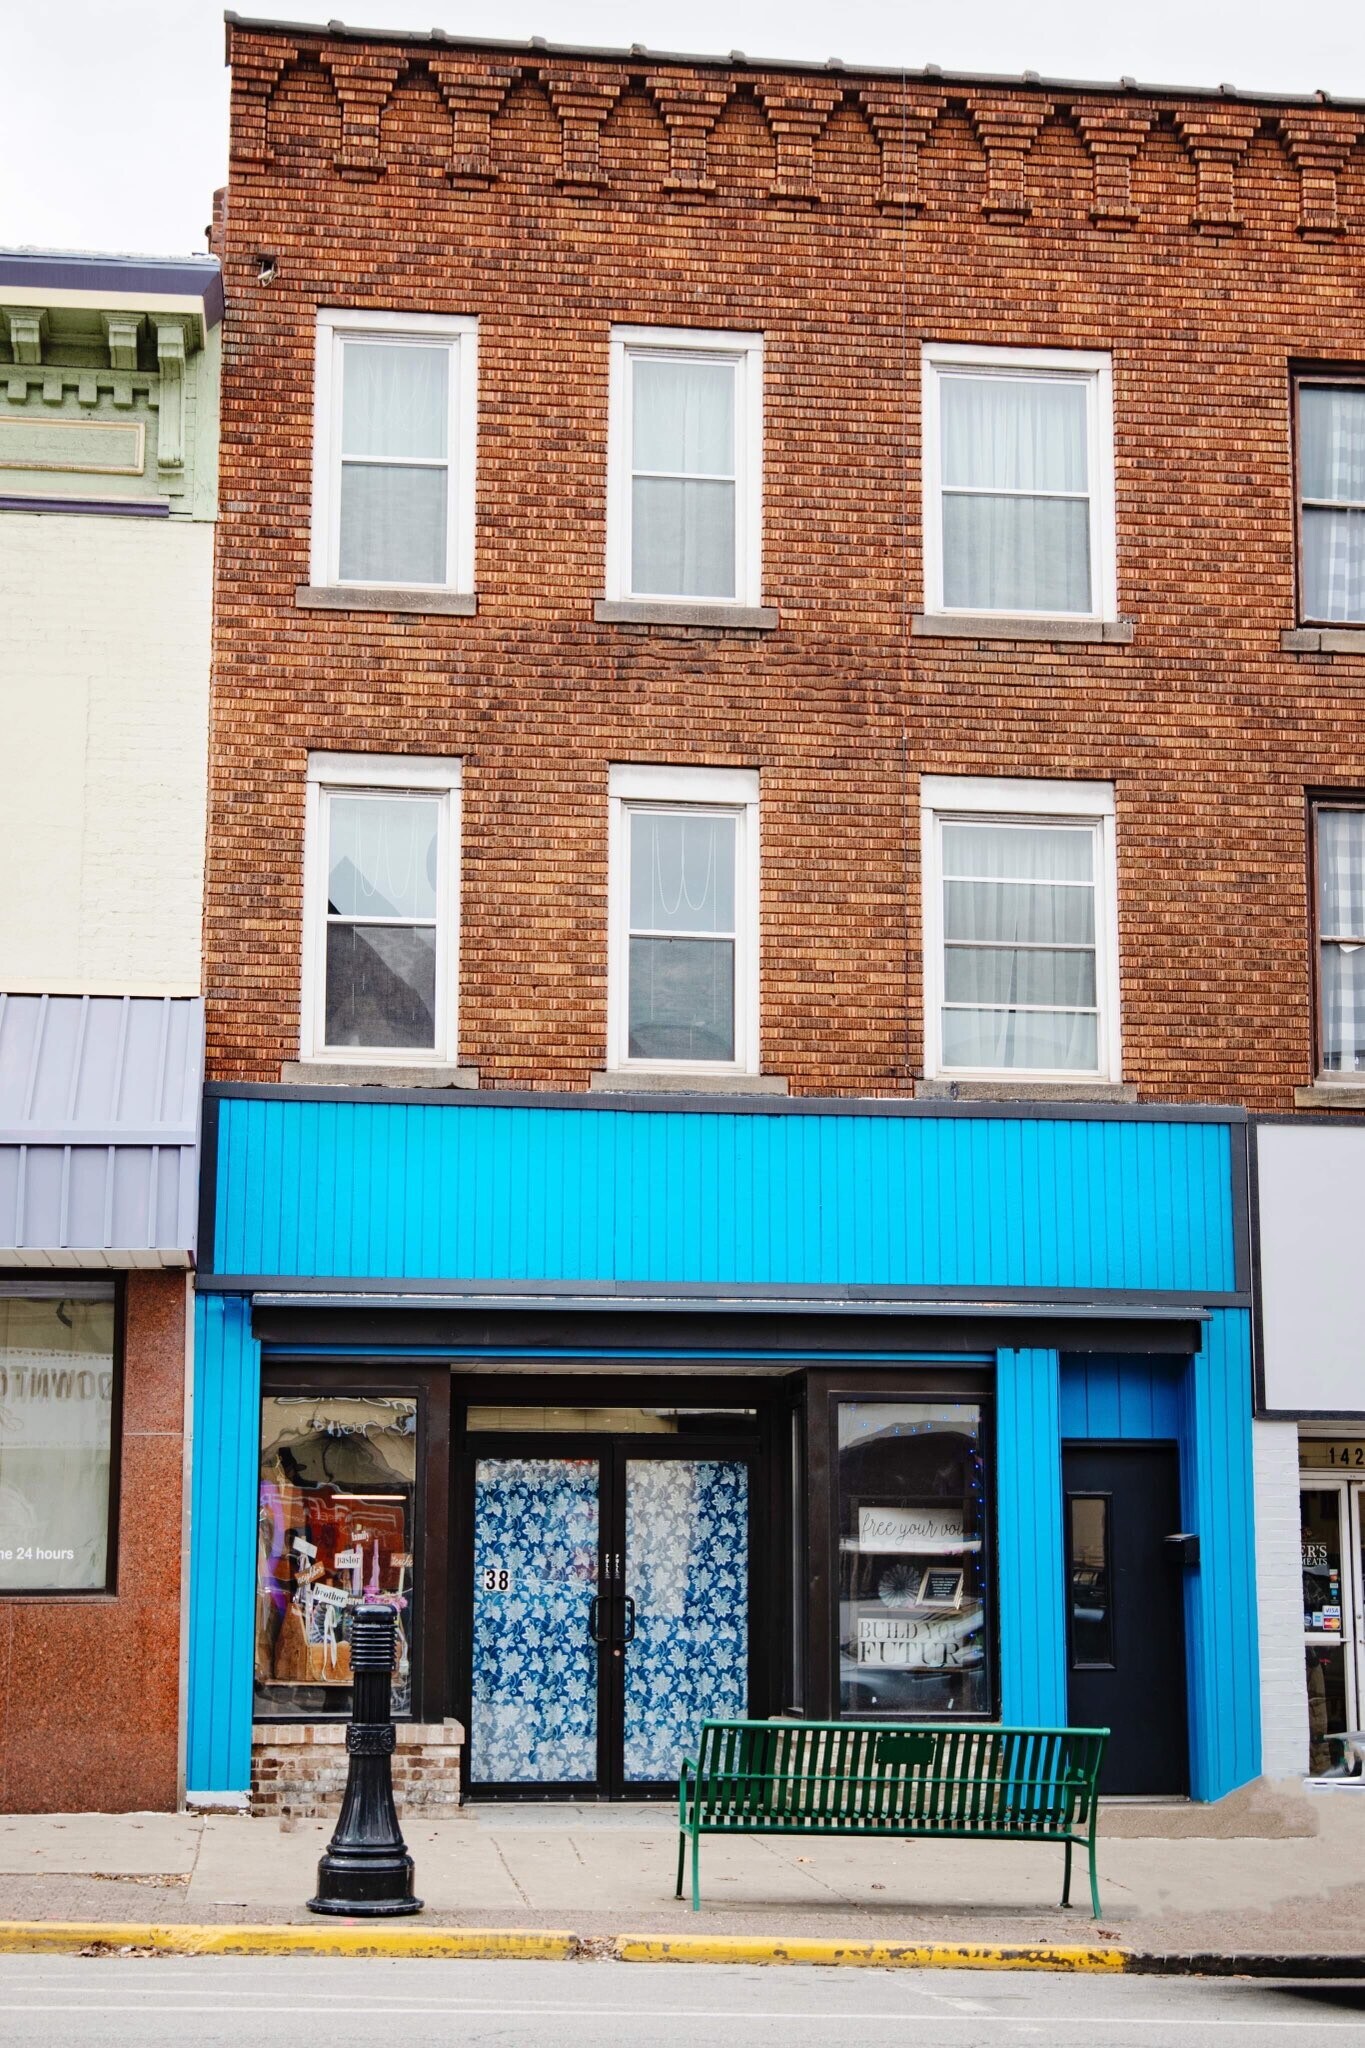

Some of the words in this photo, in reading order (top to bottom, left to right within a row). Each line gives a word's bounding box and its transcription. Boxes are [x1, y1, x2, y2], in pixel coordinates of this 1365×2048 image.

[1329, 1447, 1364, 1465] 142
[862, 1513, 897, 1543] free
[895, 1520, 938, 1545] your
[16, 1547, 33, 1560] 24
[36, 1546, 75, 1560] hours
[336, 1555, 361, 1566] pastor
[485, 1570, 509, 1590] 38
[314, 1586, 346, 1603] brother
[860, 1621, 918, 1639] BUILD
[860, 1641, 960, 1665] FUTUR
